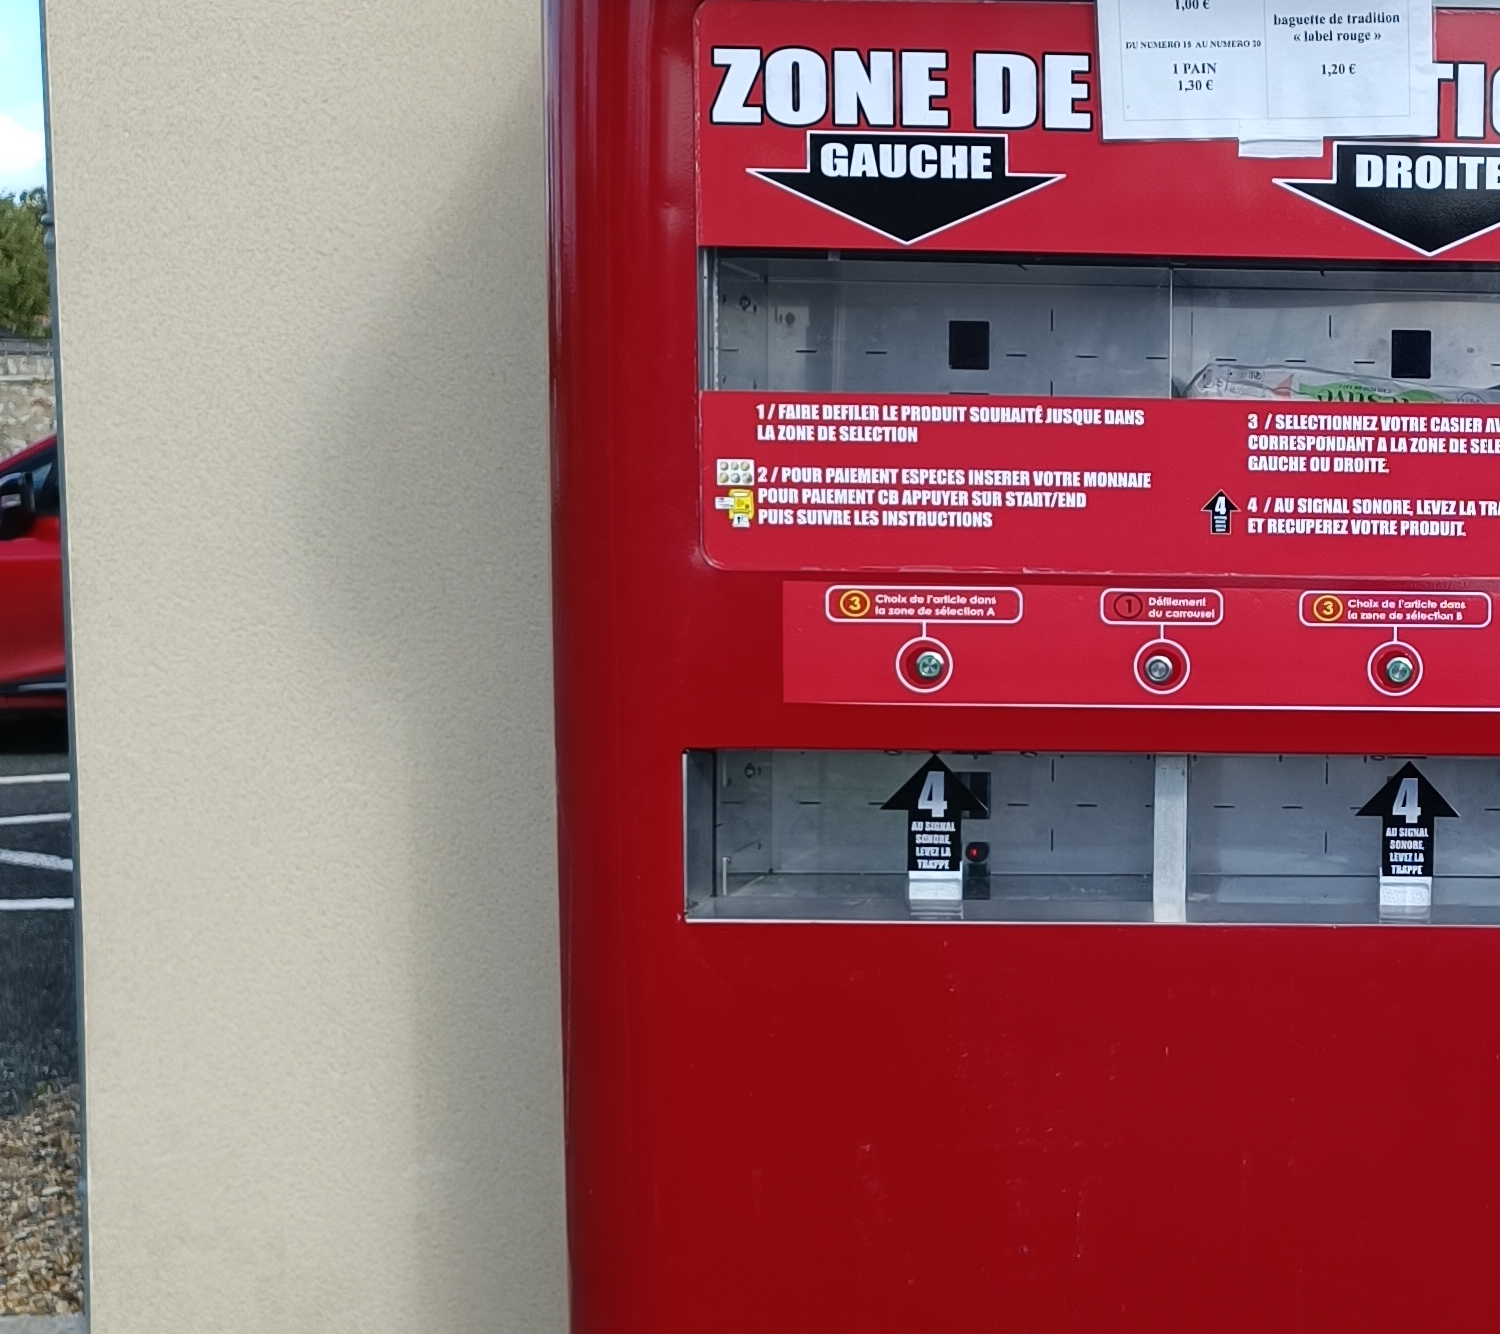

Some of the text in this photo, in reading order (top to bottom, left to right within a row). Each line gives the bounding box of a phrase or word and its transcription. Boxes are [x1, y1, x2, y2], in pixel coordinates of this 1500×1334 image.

[1175, 0, 1199, 11] 1,00
[1274, 12, 1400, 28] baguette de tradition
[1304, 30, 1371, 43] label rouge
[1125, 40, 1250, 49] DU NUMERO AU NUMERO
[1173, 63, 1217, 75] 1 PAIN
[1322, 63, 1357, 77] 1,20 €
[711, 46, 950, 127] ZONE
[974, 51, 1092, 130] DE
[1178, 79, 1214, 92] 1,30 €
[820, 142, 993, 180] GAUCHE
[756, 404, 1145, 426] 1 FAIRE DEFILER LE PRODUIT SOUHAITÉ JUSQUE DANS
[1247, 413, 1258, 430] 3
[1275, 414, 1379, 431] SELECTIONNEZ
[1380, 415, 1428, 433] VOTRE
[1430, 416, 1483, 433] CASIER
[757, 425, 918, 443] LA ZONE DE SELECTION
[1248, 434, 1375, 452] CORRESPONDANT
[1377, 437, 1388, 453] A
[1390, 437, 1409, 453] LA
[1410, 437, 1447, 453] ZONE
[1449, 438, 1467, 454] DE
[1248, 456, 1390, 474] GAUCHE OU DROITE.
[757, 467, 1151, 489] 2 POUR PAIEMENT ESPECES INSERER VOTRE MONNAIE
[758, 488, 1086, 508] POUR PAIEMENT CB APPUYER SUR START/END
[1215, 496, 1226, 515] 4
[1247, 497, 1258, 513] 4
[1274, 497, 1295, 513] AU
[1297, 498, 1350, 514] SIGNAL
[1352, 498, 1413, 517] SONORE,
[1416, 500, 1457, 515] LEVEZ
[1459, 500, 1476, 516] LA
[758, 509, 993, 528] PUIS SUIVRE LES INSTRUCTIONS
[1248, 518, 1266, 534] ET
[1267, 519, 1349, 535] RECUPEREZ
[1351, 519, 1398, 536] VOTRE
[875, 593, 907, 604] Choix
[910, 594, 924, 604] de
[926, 595, 967, 605] l'article
[969, 595, 996, 605] dans
[1148, 596, 1207, 607] Défilement
[1348, 598, 1379, 609] Choix
[1381, 599, 1396, 609] de
[1399, 599, 1437, 609] l'article
[1440, 599, 1466, 610] dans
[875, 605, 996, 617] la zone de sélection A
[1148, 609, 1215, 619] du carrousel
[1348, 610, 1463, 621] la zone de sélection B
[918, 771, 948, 818] 4
[1392, 778, 1421, 824] 4
[911, 821, 956, 832] AU SIGNAL
[1386, 827, 1429, 837] AU SIGNAL
[916, 847, 952, 857] LEVEZ LA
[1389, 852, 1424, 863] LEVEZ LA
[917, 859, 950, 870] TRAPPE
[1391, 865, 1424, 875] TRAPPE
